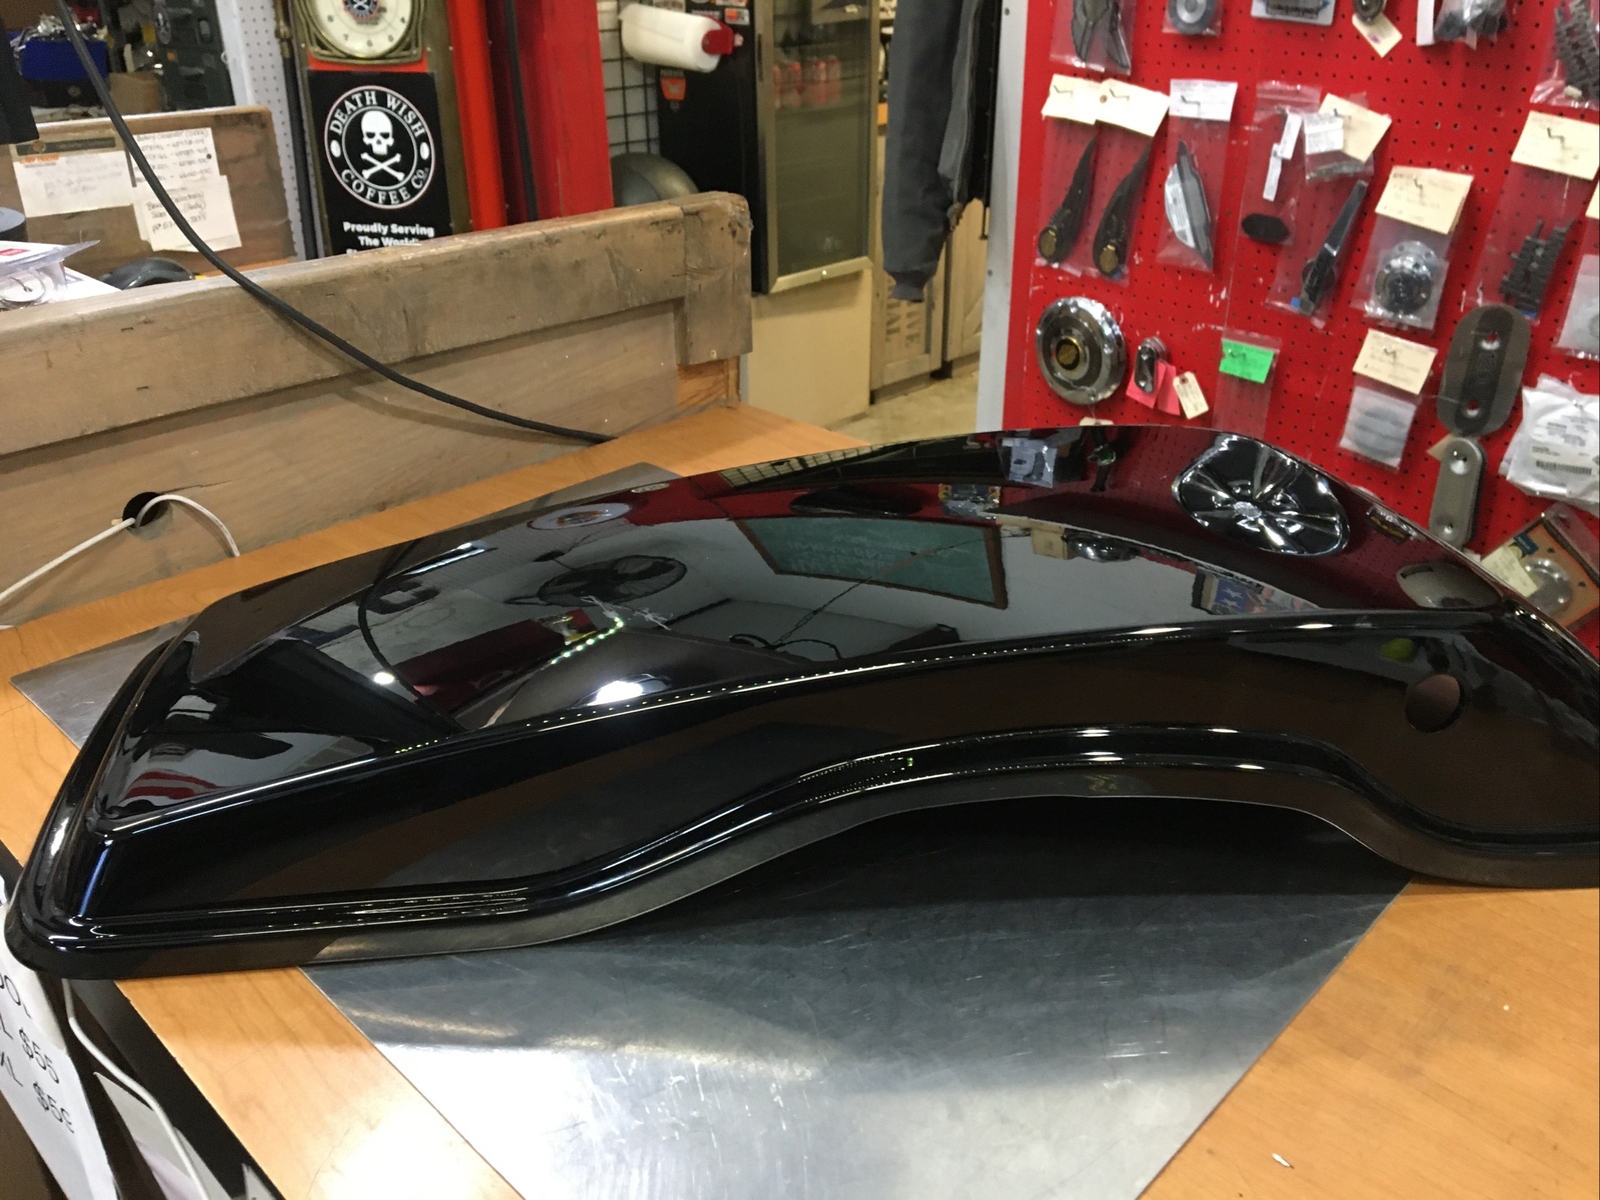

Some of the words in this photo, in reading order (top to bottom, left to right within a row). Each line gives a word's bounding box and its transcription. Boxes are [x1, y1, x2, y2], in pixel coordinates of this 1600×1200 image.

[329, 90, 378, 136] DEATH
[386, 93, 426, 138] WISH
[341, 169, 411, 205] COFFEE
[342, 221, 389, 236] Proudly
[390, 223, 435, 238] Serving
[357, 235, 380, 247] The
[19, 1027, 59, 1084] $55
